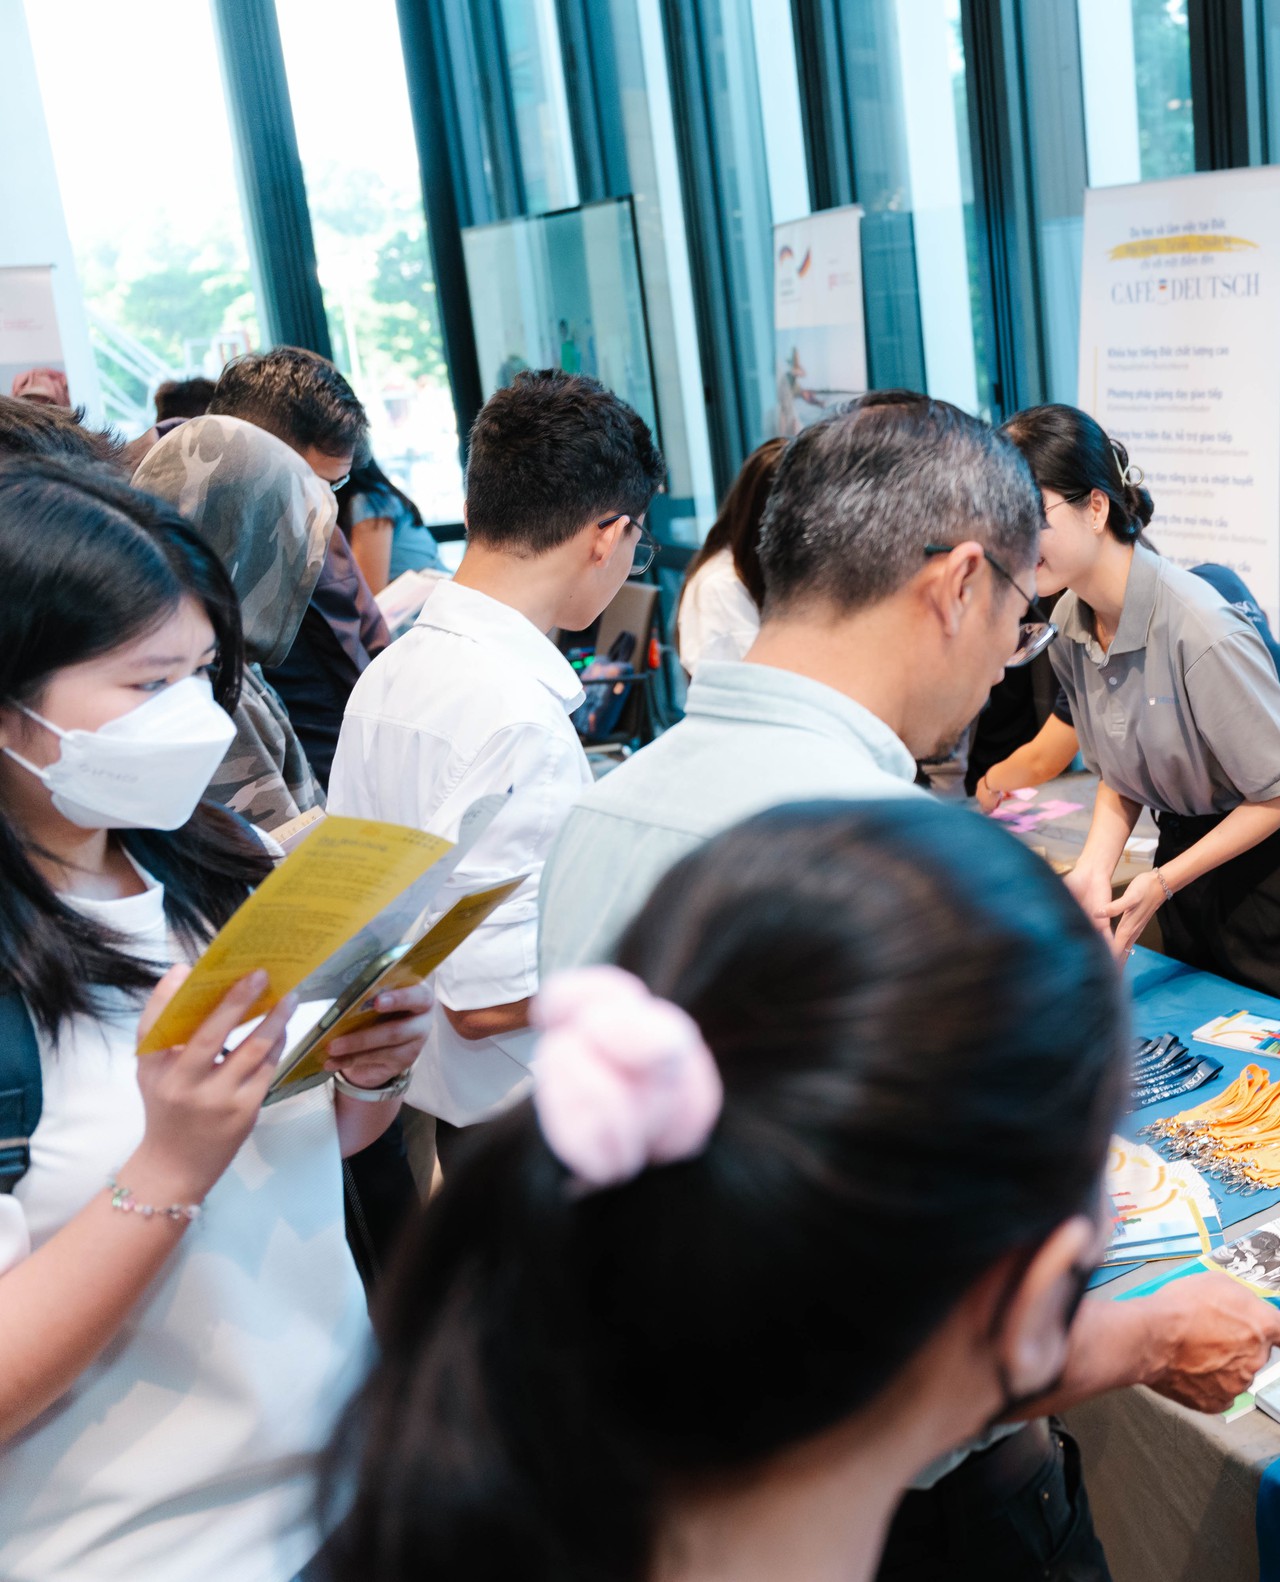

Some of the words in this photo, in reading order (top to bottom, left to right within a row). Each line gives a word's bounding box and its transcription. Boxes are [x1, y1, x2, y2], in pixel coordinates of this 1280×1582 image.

[1111, 278, 1154, 304] CAFÉ
[1172, 272, 1260, 301] DEUTSCH
[1168, 1070, 1205, 1096] DEUTSCH
